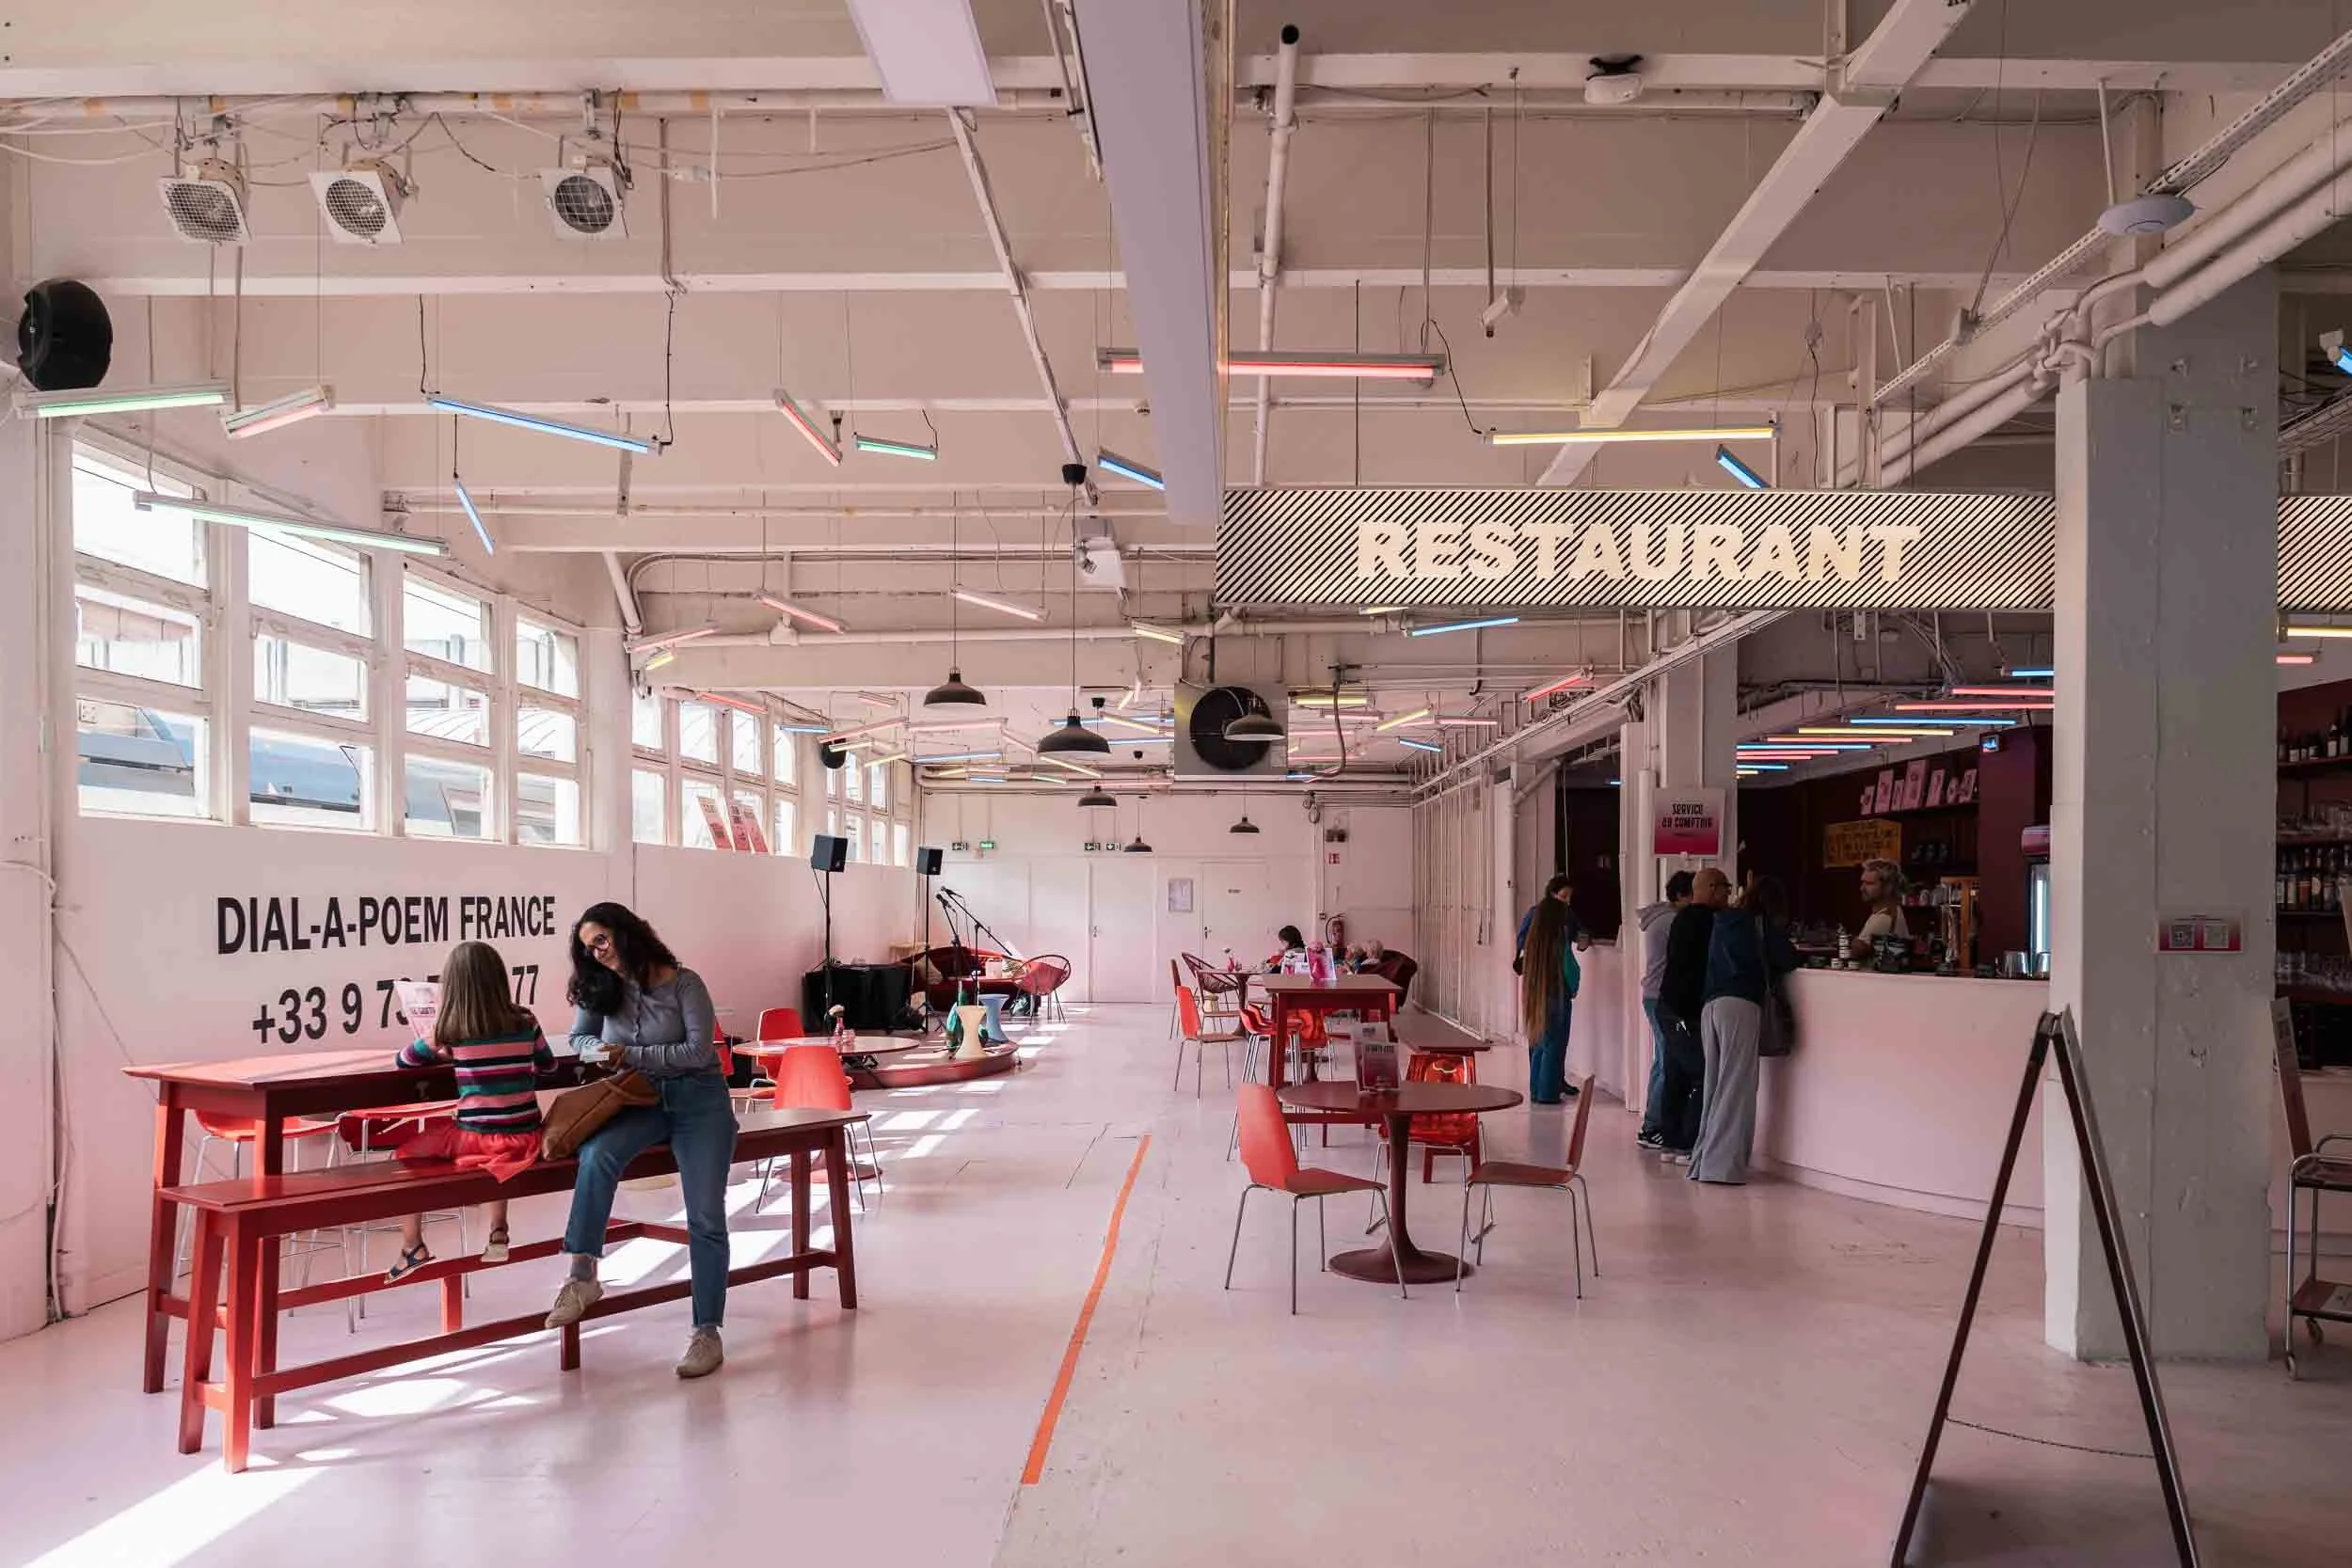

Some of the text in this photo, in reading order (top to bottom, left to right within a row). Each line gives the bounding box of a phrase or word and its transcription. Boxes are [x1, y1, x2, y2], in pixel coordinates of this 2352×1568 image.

[1358, 521, 1922, 582] RESTAURANT
[217, 895, 556, 954] DIAL-A-POEM FRANCE
[252, 986, 326, 1044] +33
[342, 982, 363, 1035] 9
